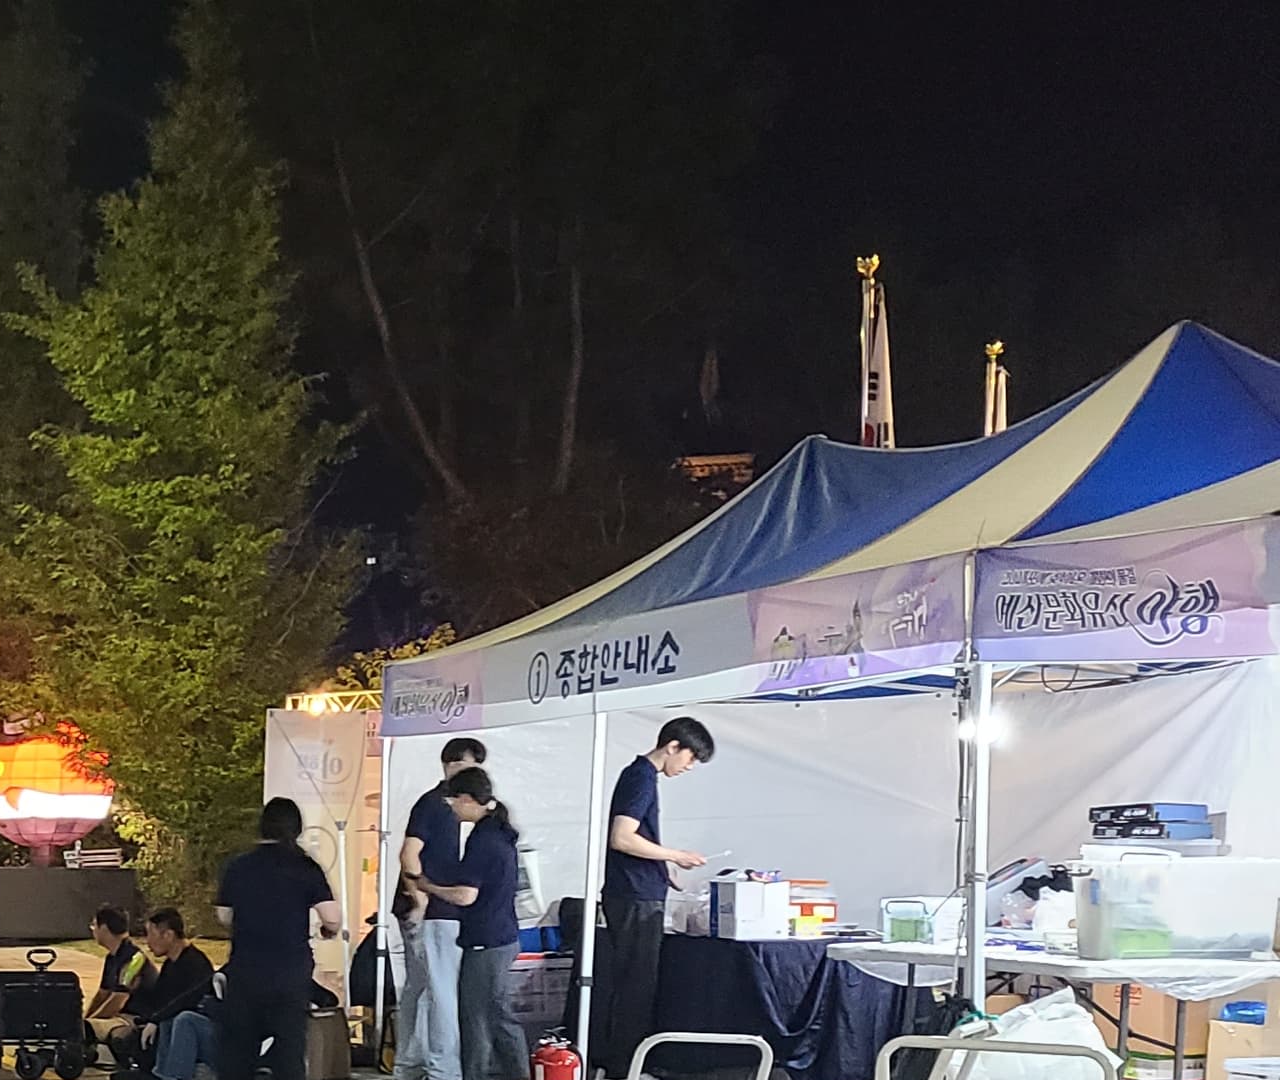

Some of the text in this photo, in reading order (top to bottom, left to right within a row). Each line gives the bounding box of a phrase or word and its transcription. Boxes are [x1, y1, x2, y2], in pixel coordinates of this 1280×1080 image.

[995, 590, 1135, 631] 예산문화유산
[1136, 574, 1221, 645] 야행
[555, 631, 680, 700] 종합안내소
